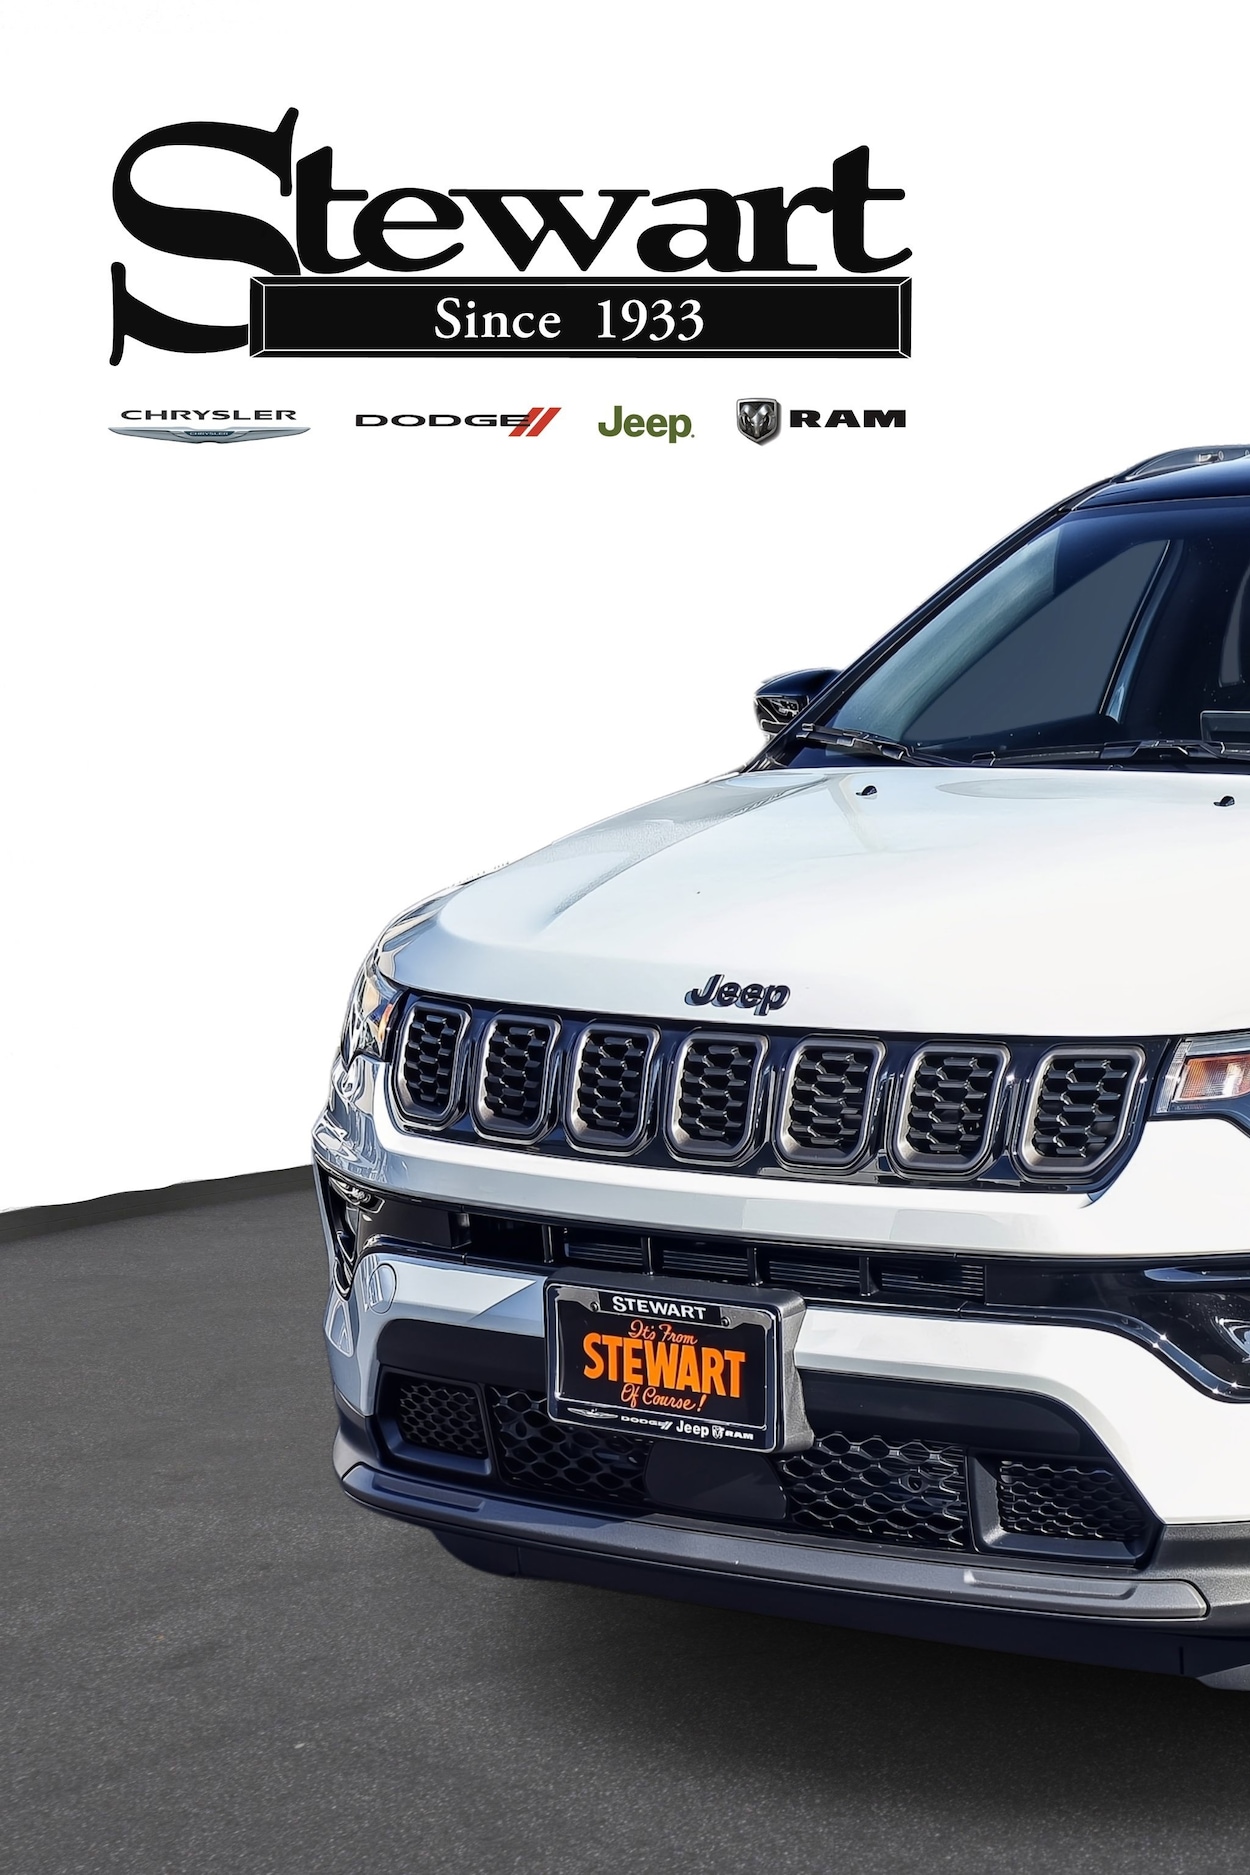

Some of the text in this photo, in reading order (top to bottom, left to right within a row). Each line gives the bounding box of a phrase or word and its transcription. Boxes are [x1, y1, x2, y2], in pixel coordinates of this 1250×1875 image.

[684, 974, 791, 1016] Jeep
[612, 1296, 706, 1320] STEWART
[658, 1323, 698, 1345] From
[582, 1332, 746, 1398] STEWART
[620, 1383, 640, 1409] Of
[675, 1419, 709, 1437] Jeep
[724, 1430, 754, 1440] RAM
